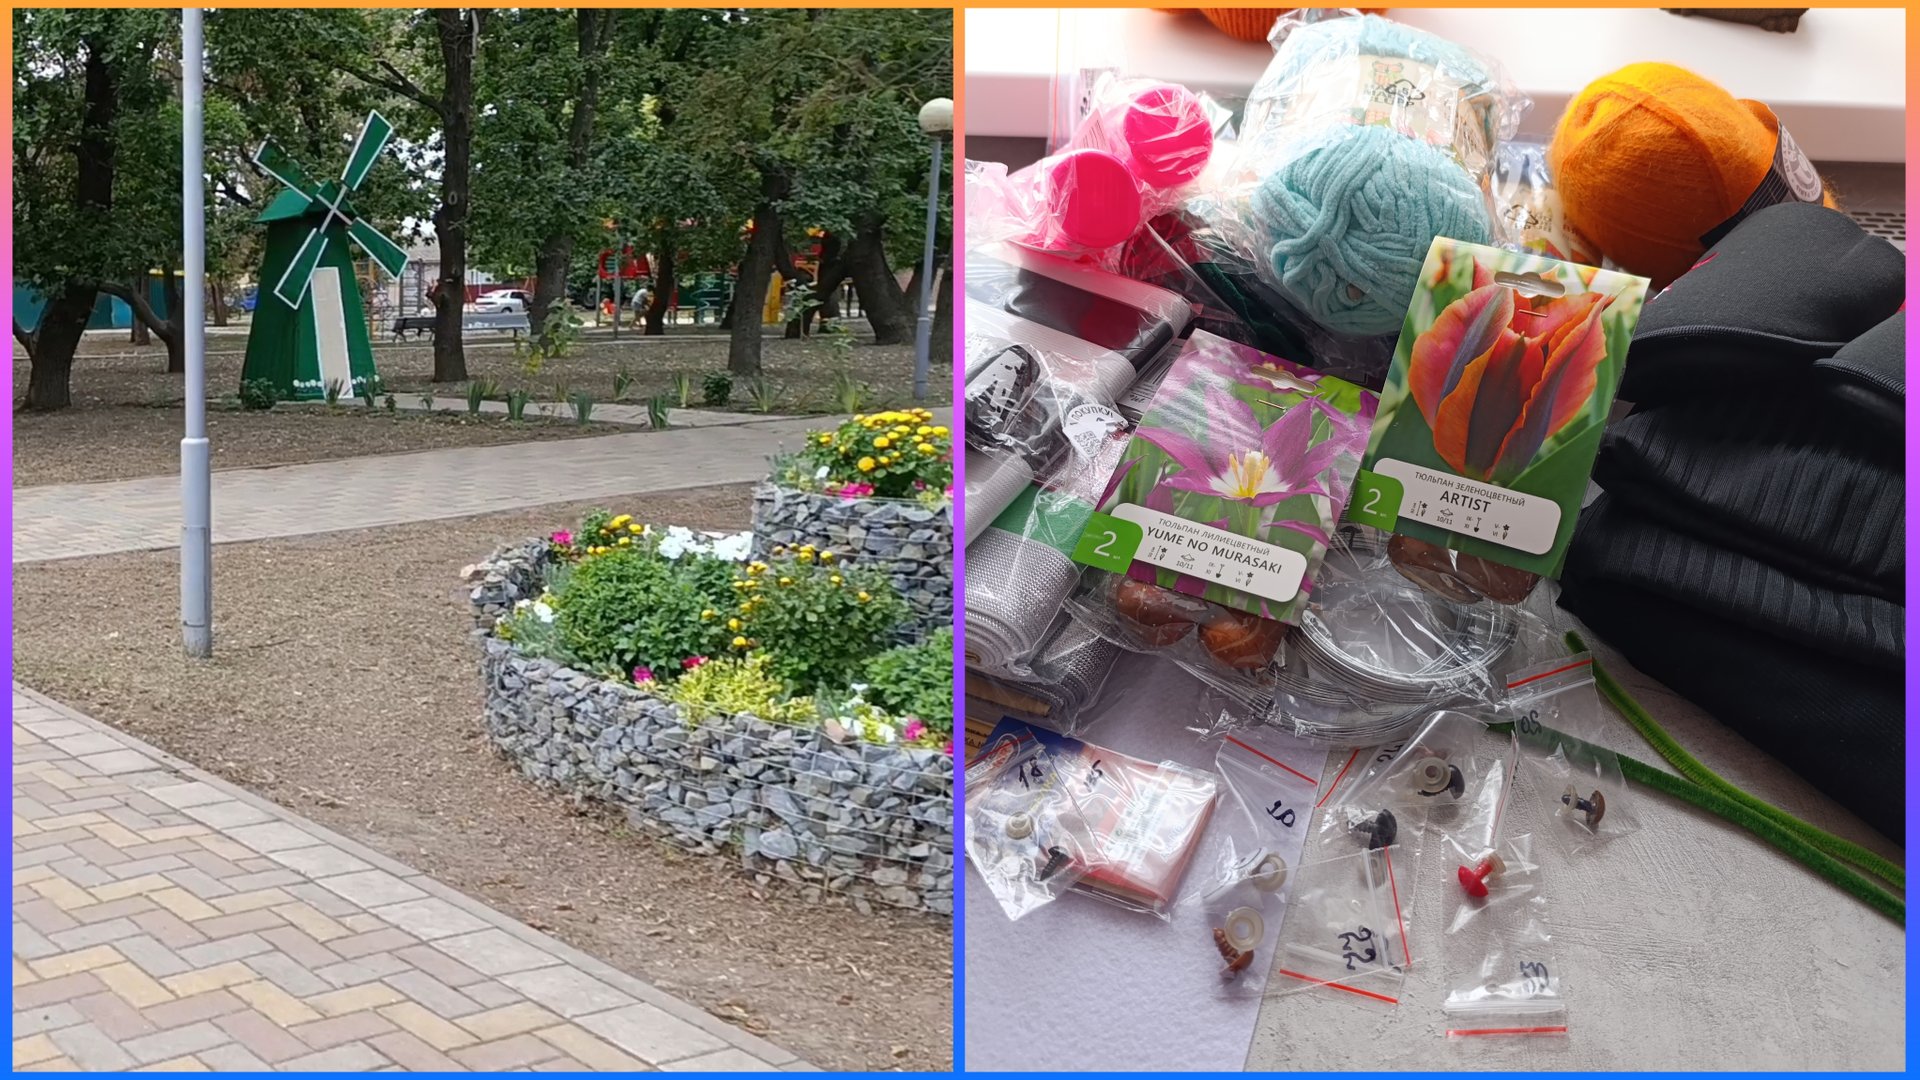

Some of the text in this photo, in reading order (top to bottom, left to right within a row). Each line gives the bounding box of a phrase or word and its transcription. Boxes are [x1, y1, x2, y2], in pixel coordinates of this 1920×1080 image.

[1363, 488, 1381, 514] 2
[1415, 472, 1526, 507] ТЮЛЬПАН ЗЕЛЕНОЦВЕТНЫЙ
[1440, 490, 1492, 513] ARTIST
[1436, 515, 1454, 525] 10/11
[1093, 531, 1117, 557] 2
[1158, 517, 1270, 556] ТЮЛЬПАН ЛИЛИЕЦВЕТНЫЙ
[1147, 526, 1282, 574] YUME NO MURASAKI
[1176, 560, 1194, 570] 10/11
[1265, 799, 1297, 828] 10
